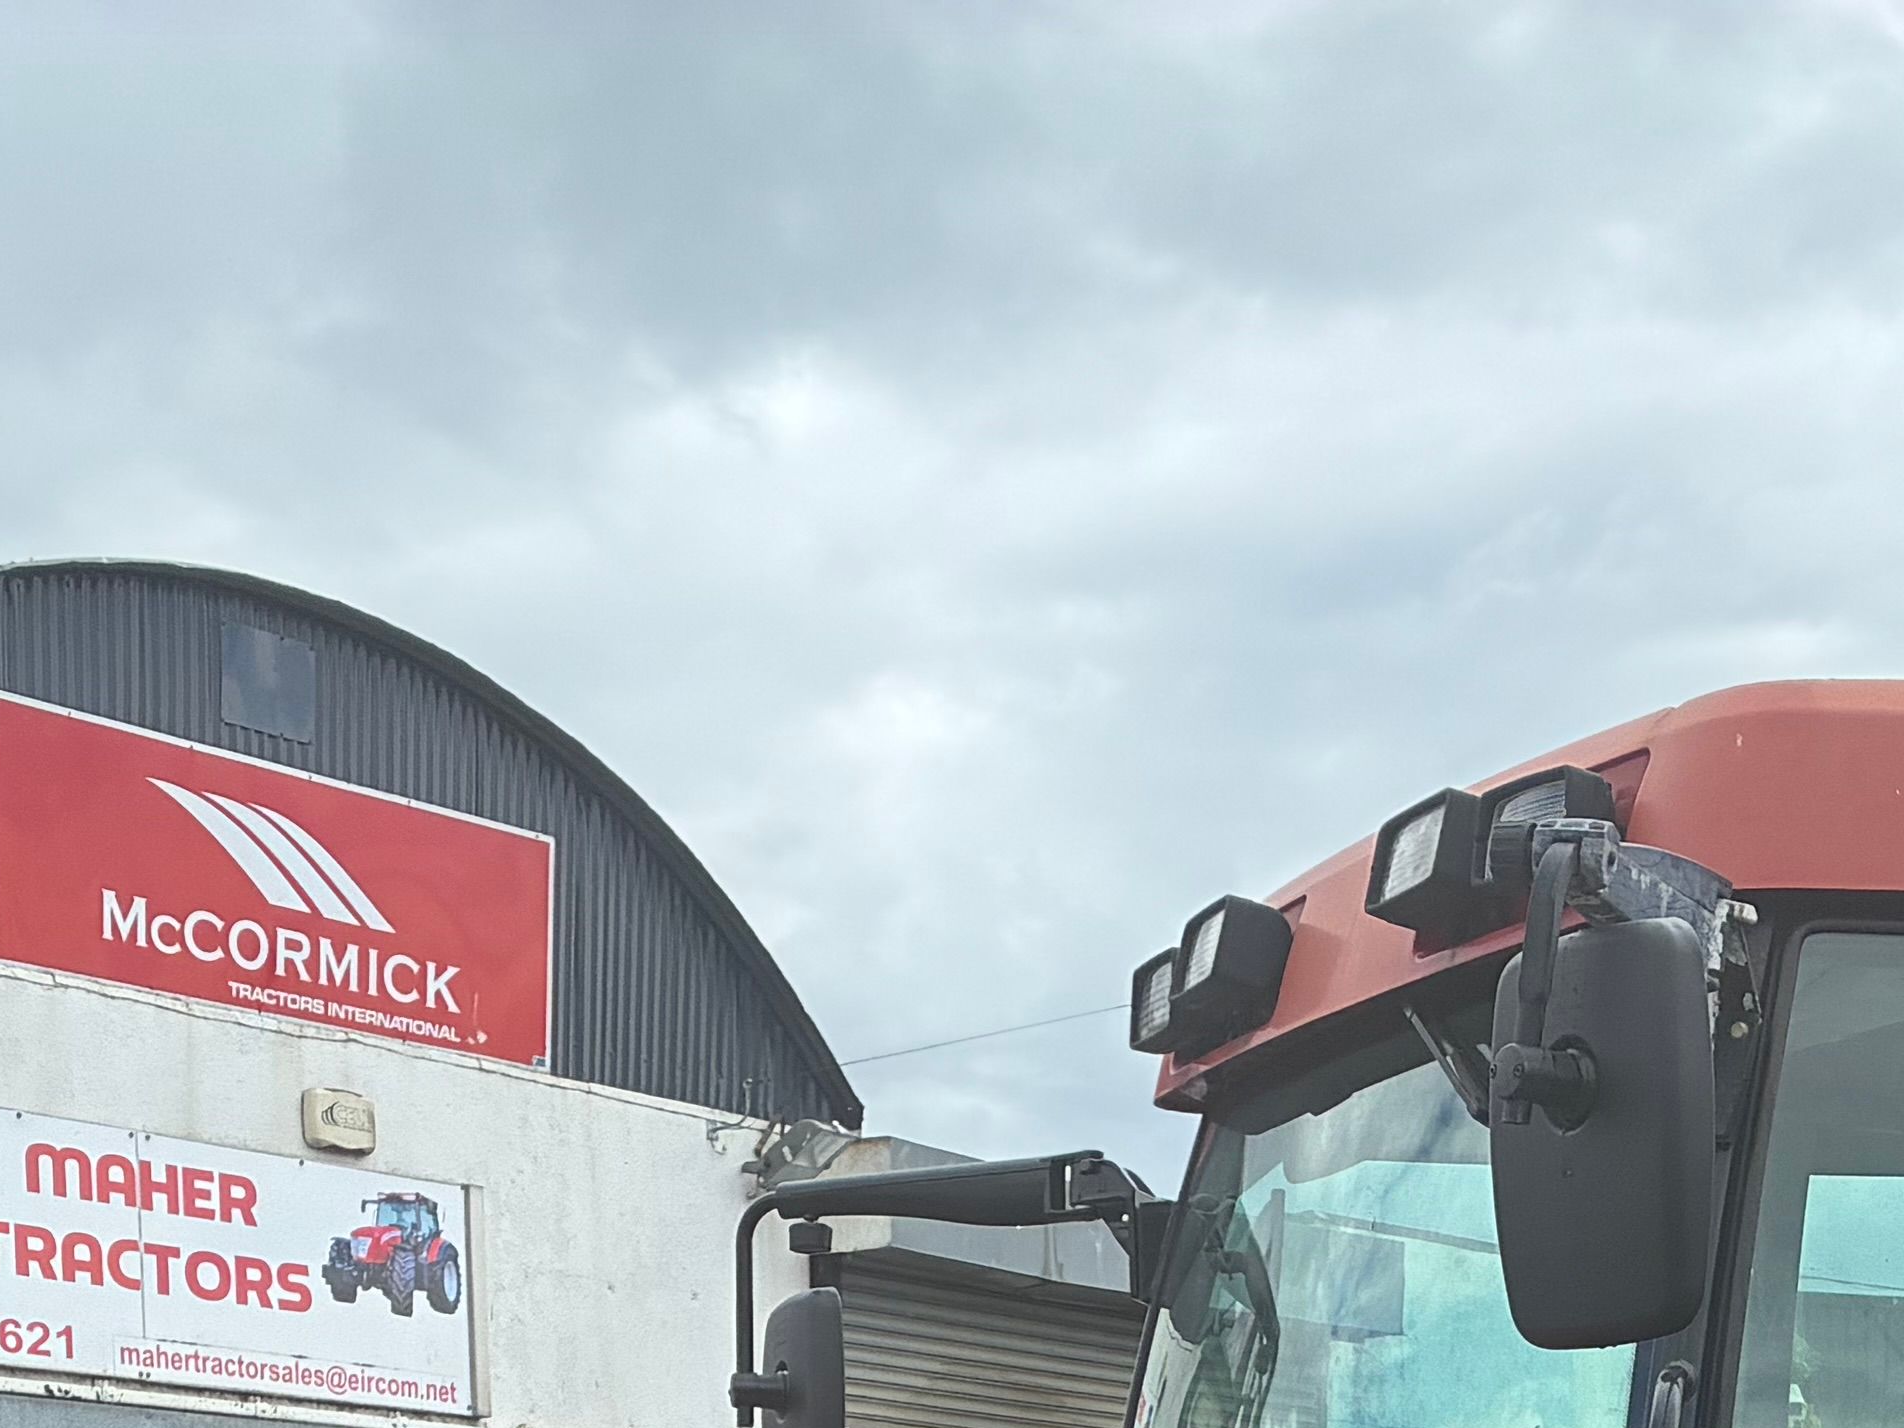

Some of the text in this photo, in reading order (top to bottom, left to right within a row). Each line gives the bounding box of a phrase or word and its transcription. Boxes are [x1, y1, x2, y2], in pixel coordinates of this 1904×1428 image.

[101, 888, 462, 1015] McCORMICK
[227, 981, 461, 1043] TRACTORS INTERNATIONAL
[25, 1142, 258, 1227] MAHER
[119, 1344, 458, 1404] mahertractorsales@eircom.net
